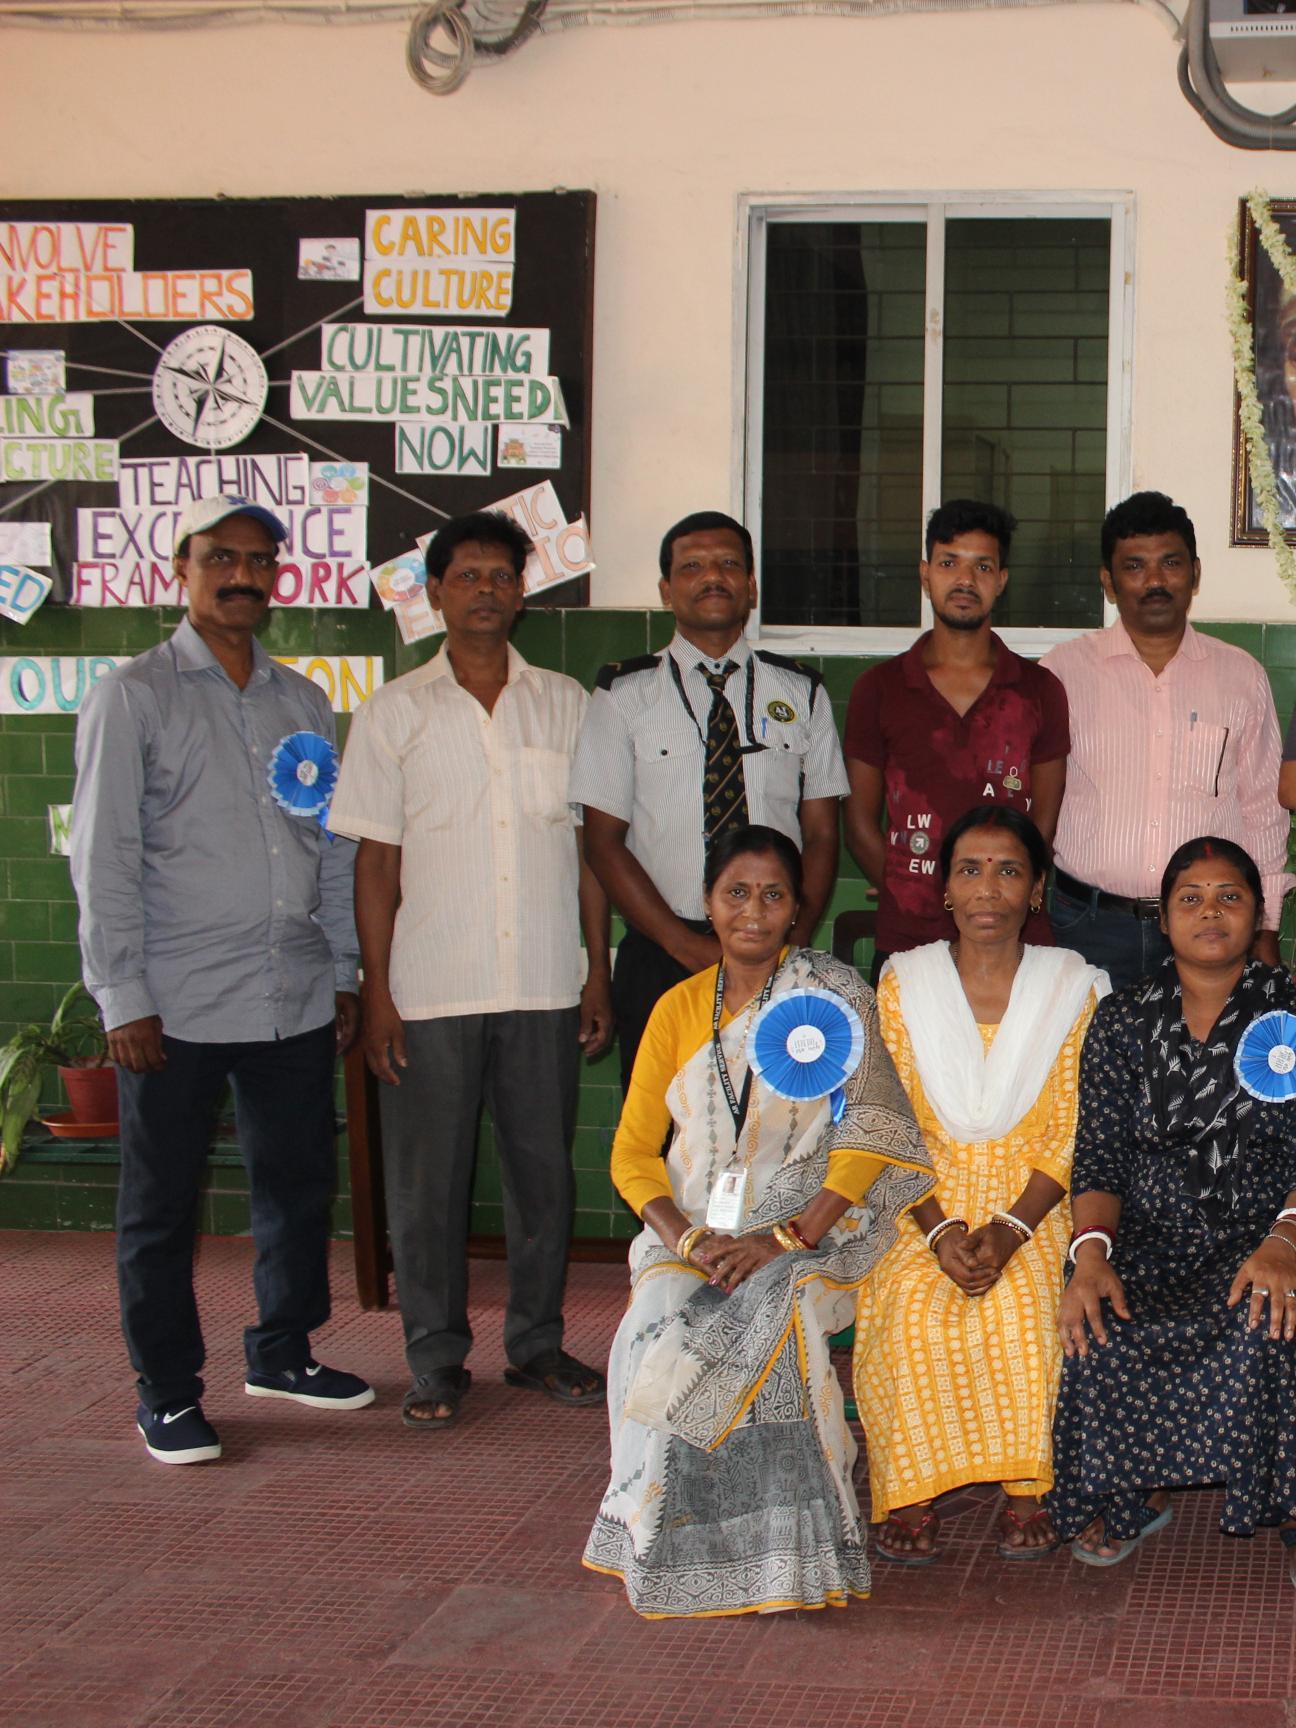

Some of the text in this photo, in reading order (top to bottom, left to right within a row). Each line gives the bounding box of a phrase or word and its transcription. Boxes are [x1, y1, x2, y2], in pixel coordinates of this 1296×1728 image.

[372, 214, 512, 257] CARING
[0, 271, 252, 321] KEHOLDERS
[372, 267, 512, 310] CULTURE
[326, 324, 532, 374] CULTIVATING
[0, 393, 84, 436] ING
[399, 425, 489, 472] NOW
[120, 456, 305, 506] TEACHING
[909, 859, 936, 875] EW
[720, 1072, 737, 1104] FACILITY
